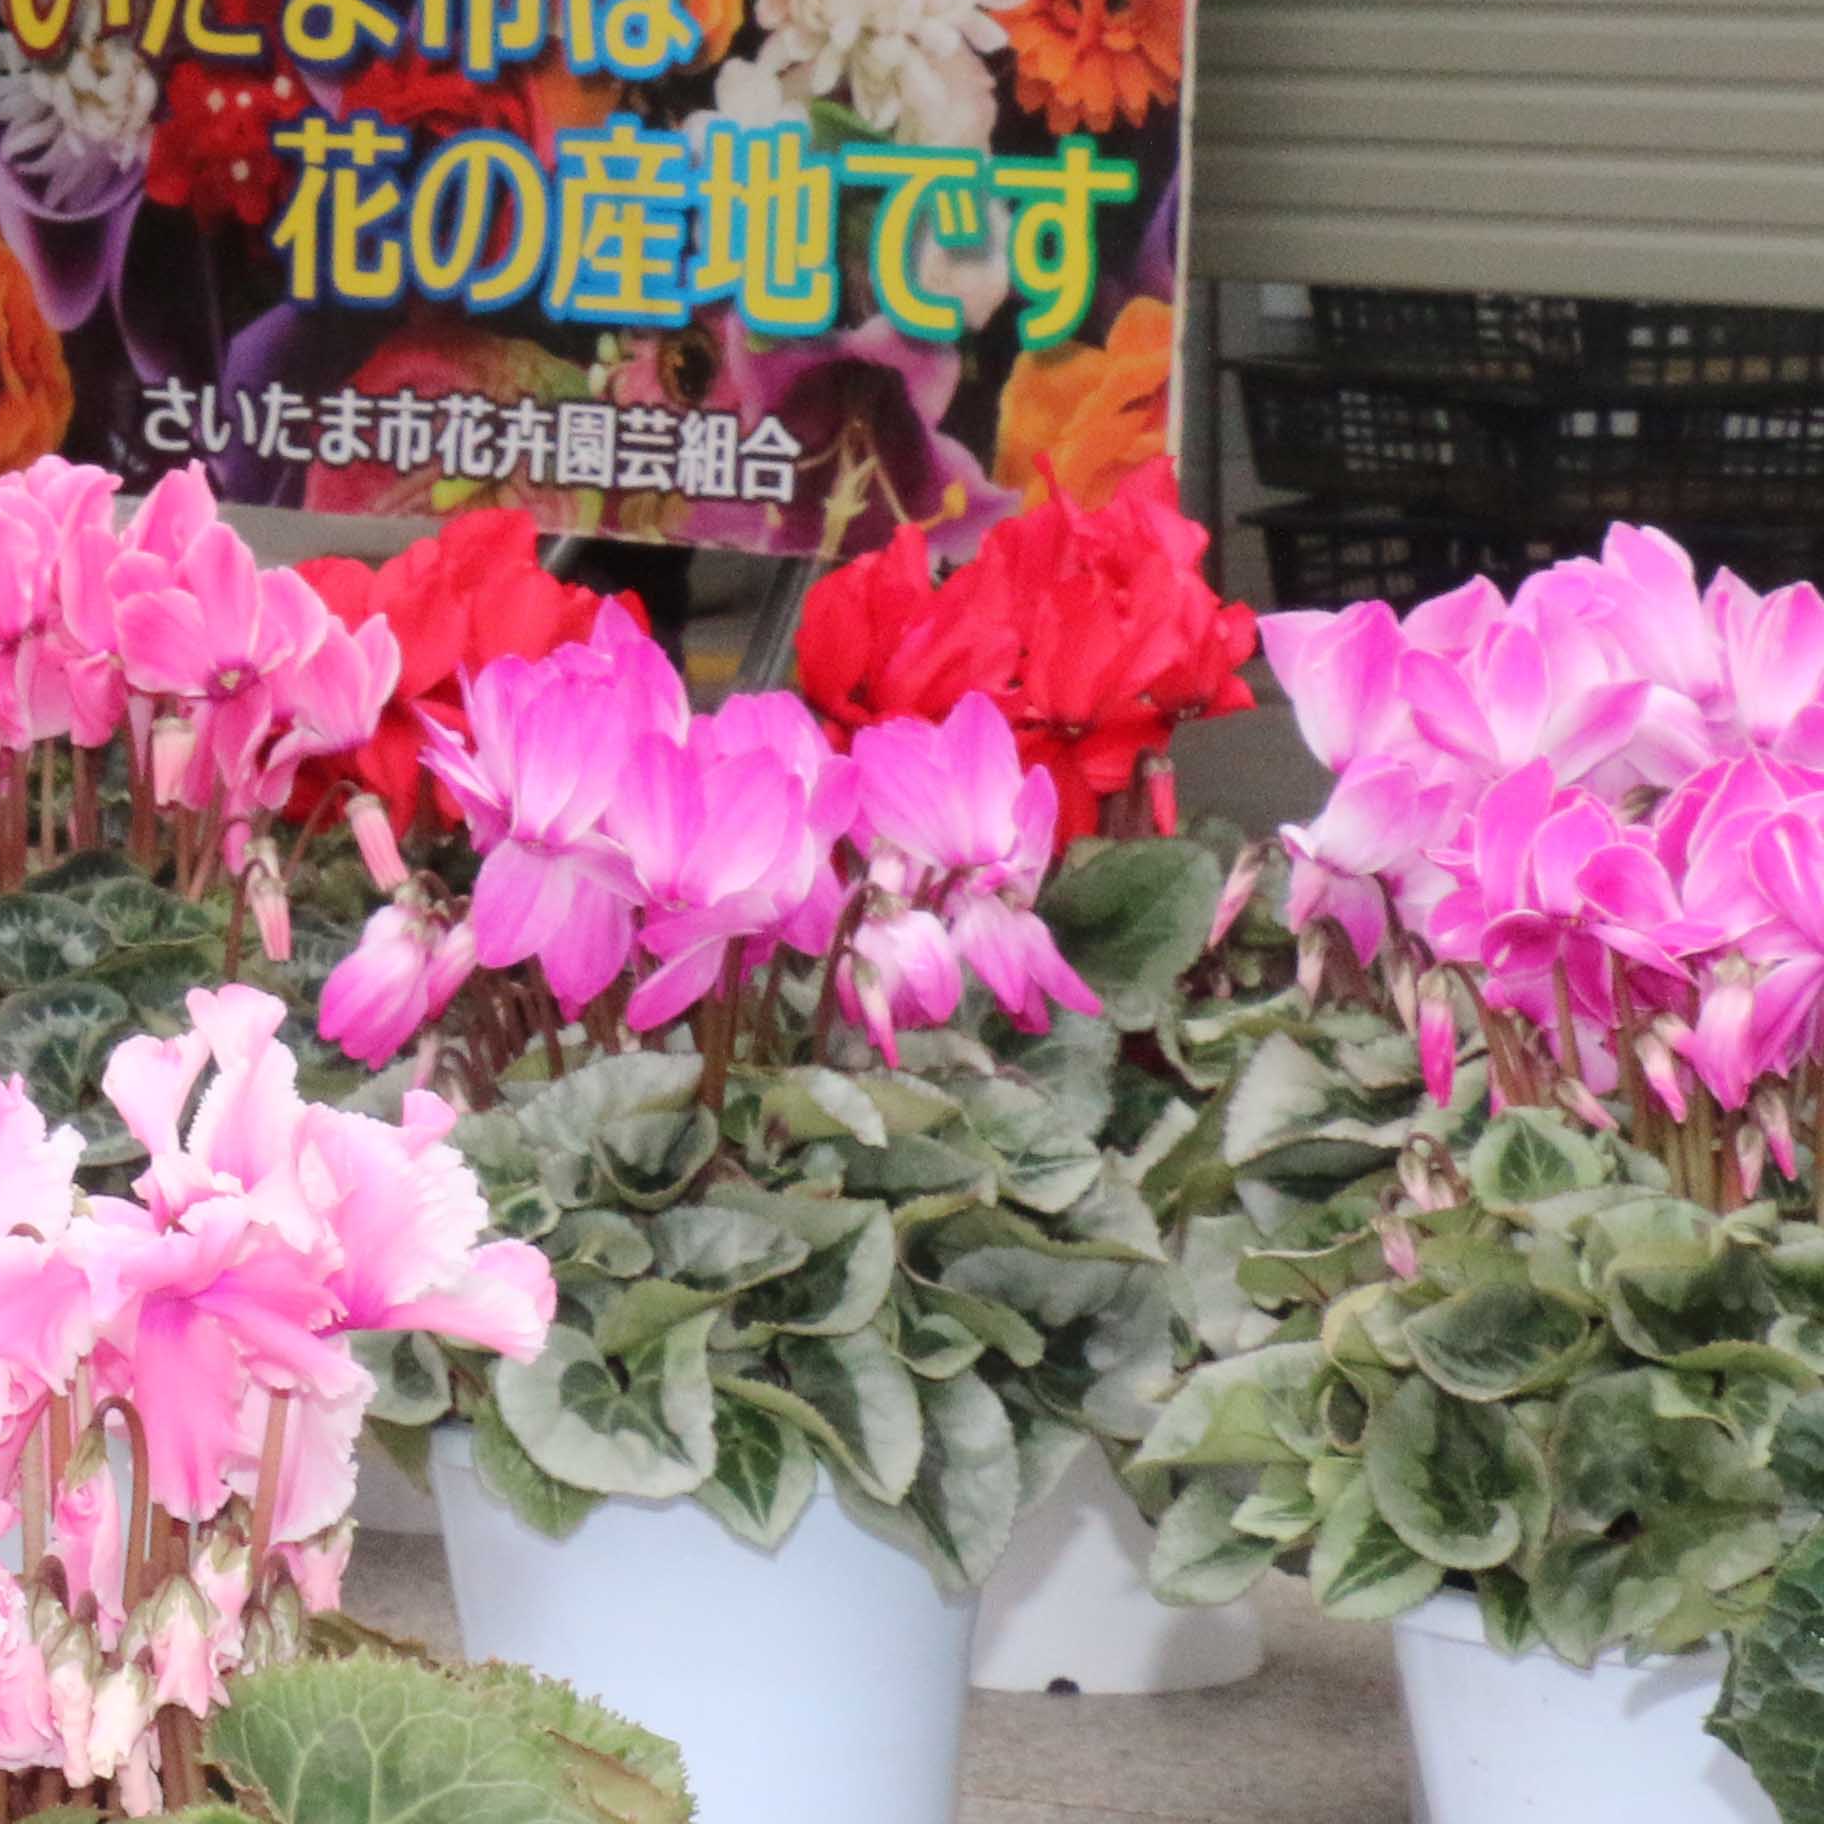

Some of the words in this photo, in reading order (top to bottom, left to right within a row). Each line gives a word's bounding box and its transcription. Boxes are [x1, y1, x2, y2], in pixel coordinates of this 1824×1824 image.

[271, 116, 1139, 348] 花の産地です
[142, 379, 803, 504] さいたま市花卉園芸組合
